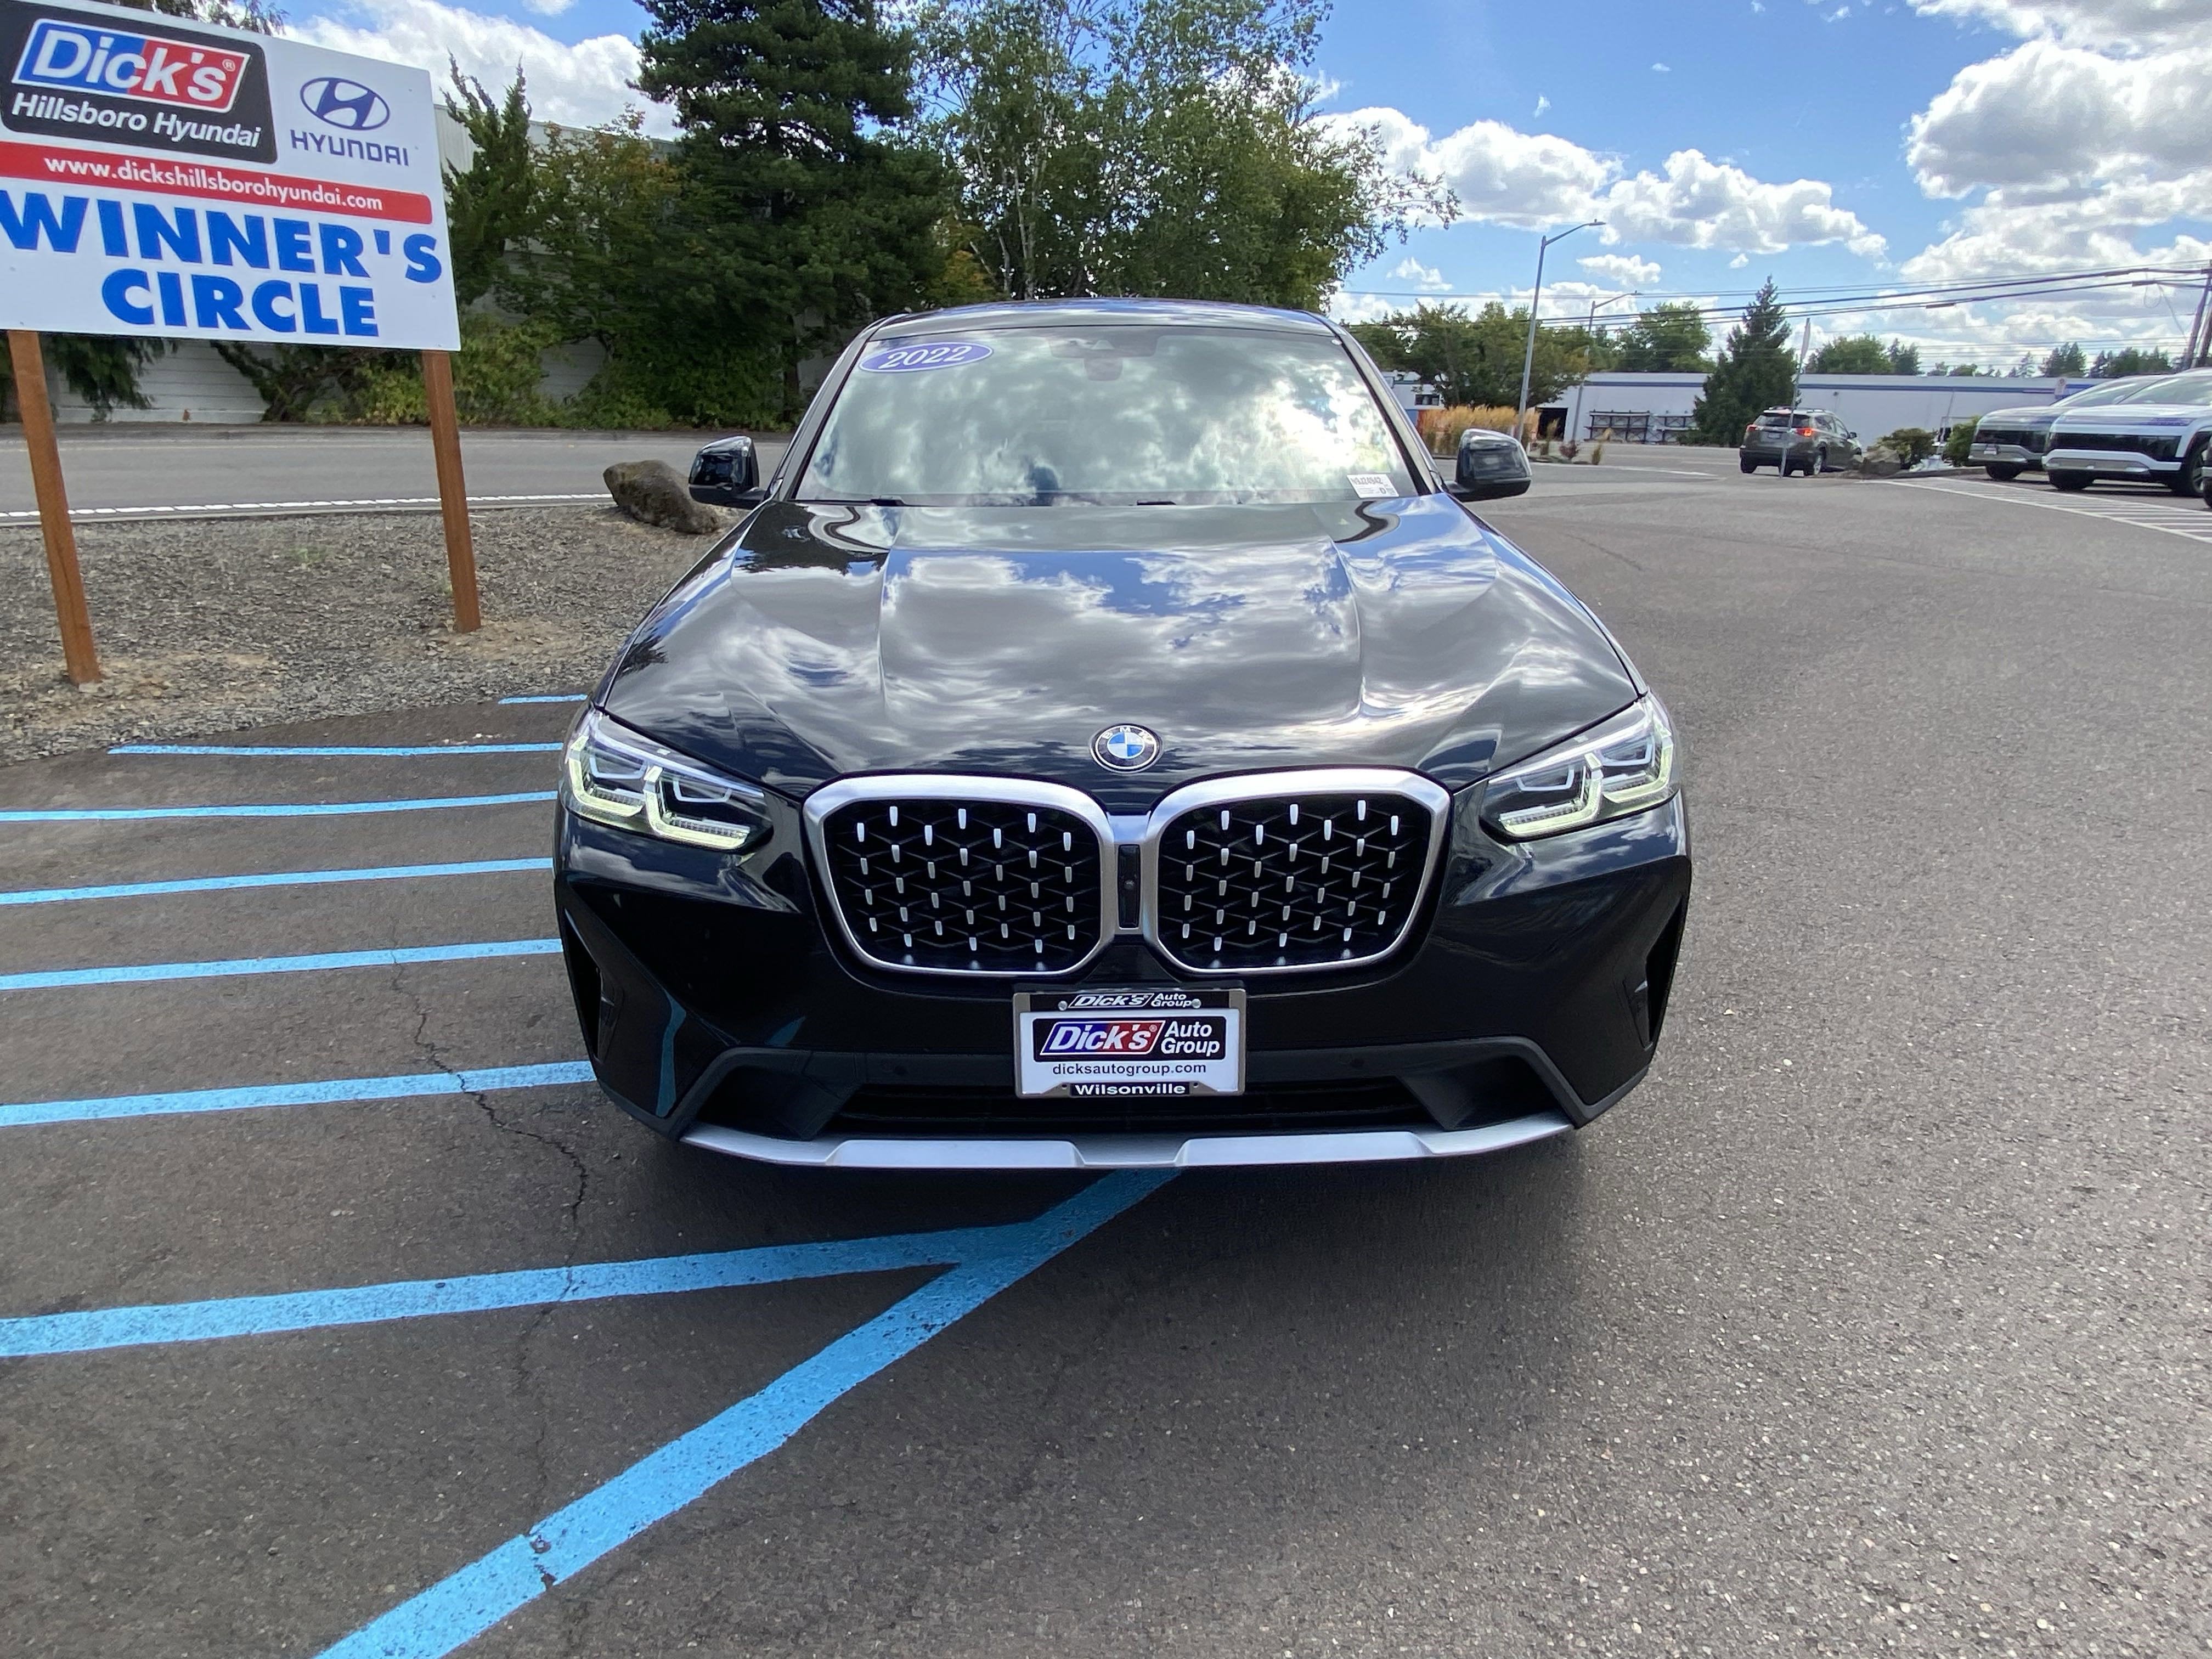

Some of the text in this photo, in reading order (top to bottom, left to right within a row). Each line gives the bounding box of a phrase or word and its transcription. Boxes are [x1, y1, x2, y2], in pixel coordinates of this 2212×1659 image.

[32, 29, 227, 101] Dick's
[12, 92, 262, 148] Hillsboro Hyundai
[290, 129, 409, 166] HYUNDAI
[44, 157, 383, 211] www.dickshillsborohyundai.com
[0, 190, 442, 284] WINNER'S
[101, 268, 379, 337] CIRCLE
[878, 345, 973, 369] 2022
[1074, 993, 1144, 1007] Dick's
[1150, 1000, 1193, 1008] Group
[1048, 1024, 1151, 1051] Dick's
[1164, 1022, 1212, 1037] Auto
[1161, 1039, 1220, 1057] Group
[1052, 1063, 1206, 1076] dicksautogroup.com
[1074, 1082, 1186, 1096] Wilsonville
